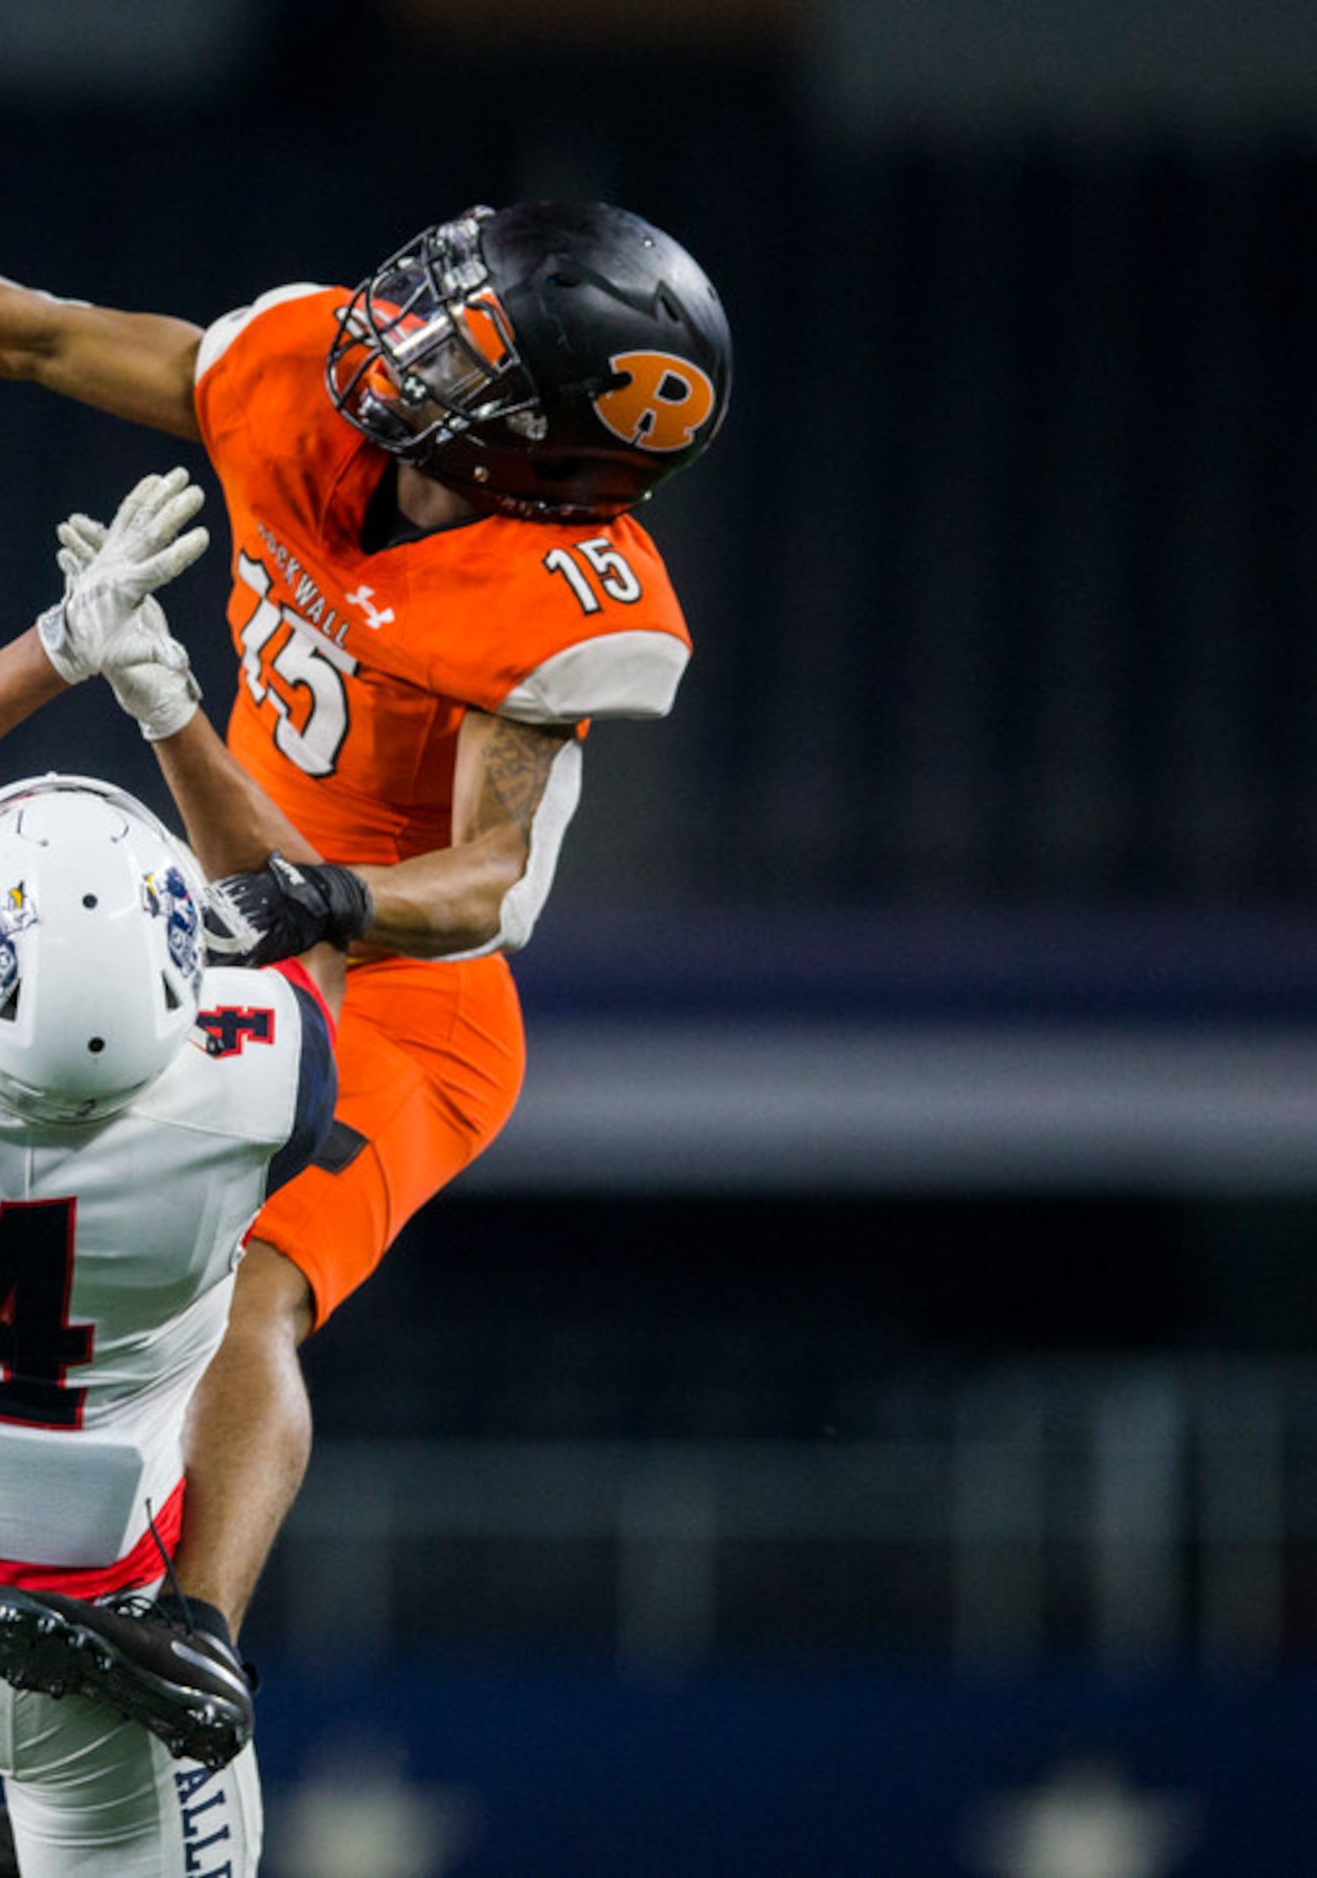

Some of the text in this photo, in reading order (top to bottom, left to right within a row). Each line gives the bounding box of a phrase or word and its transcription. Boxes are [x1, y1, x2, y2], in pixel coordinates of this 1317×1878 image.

[593, 350, 715, 452] R
[542, 535, 643, 616] 15
[237, 547, 362, 778] 15
[196, 1006, 275, 1059] 4
